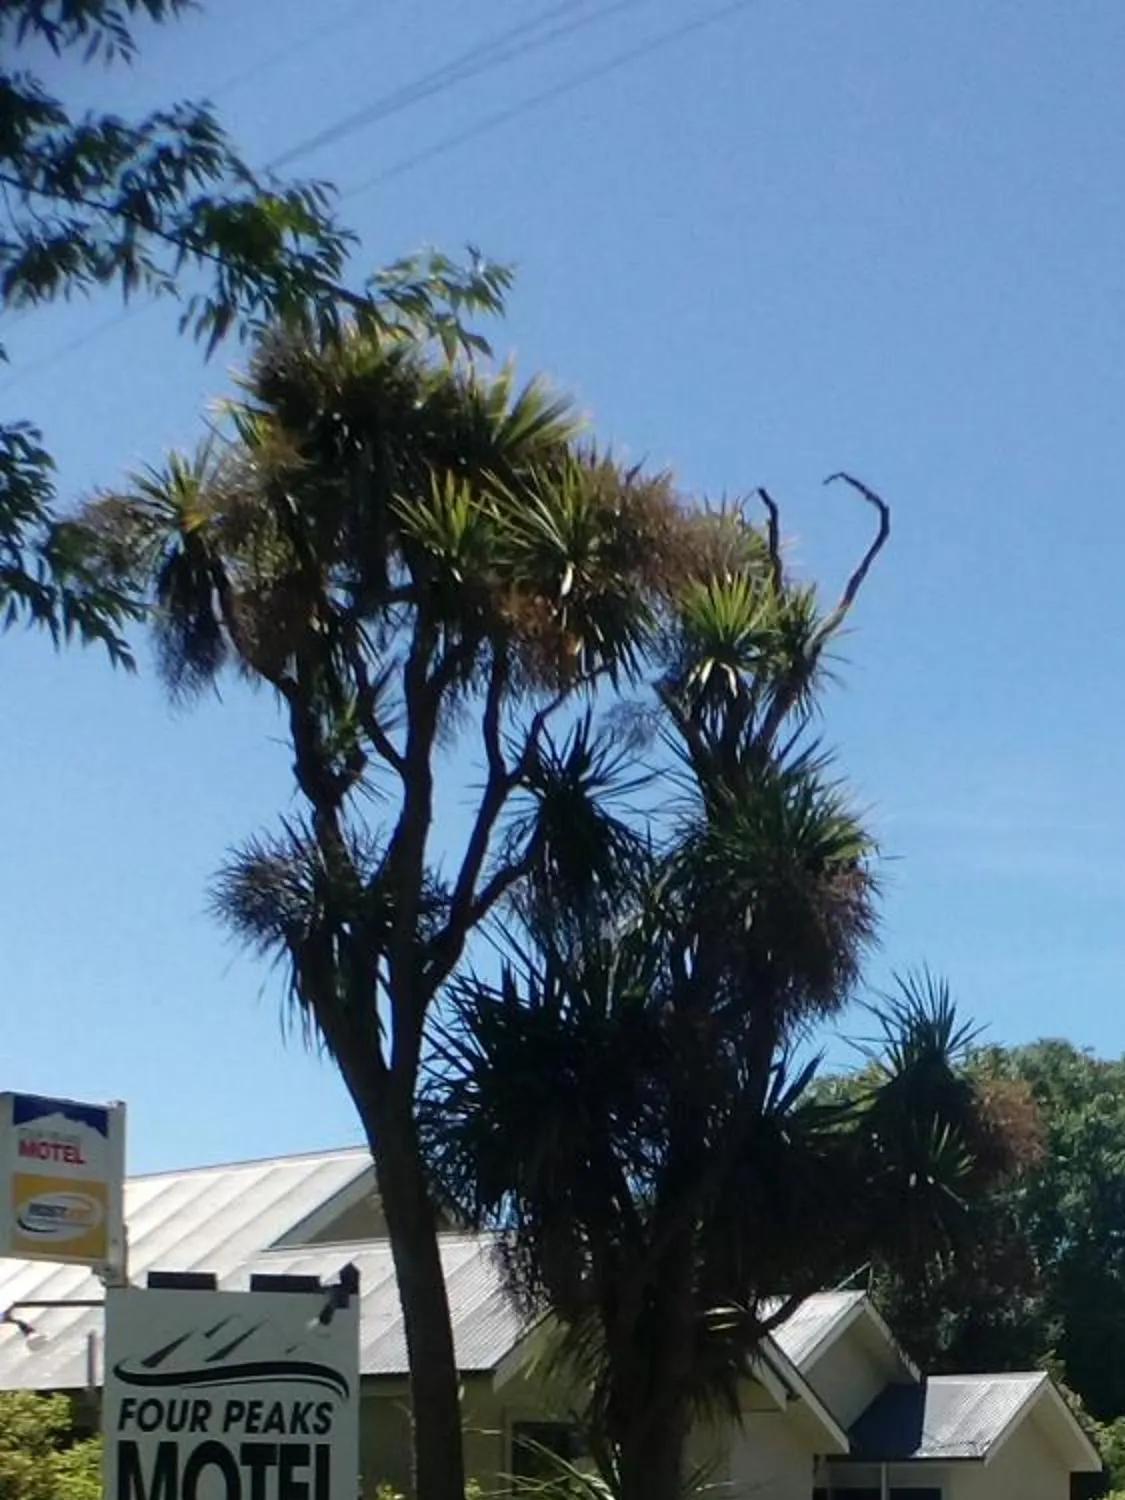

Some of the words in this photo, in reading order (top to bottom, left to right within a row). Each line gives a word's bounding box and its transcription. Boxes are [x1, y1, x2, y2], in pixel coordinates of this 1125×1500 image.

[18, 1138, 86, 1165] MOTEL
[118, 1398, 212, 1432] FOUR
[223, 1401, 333, 1435] PEAKS
